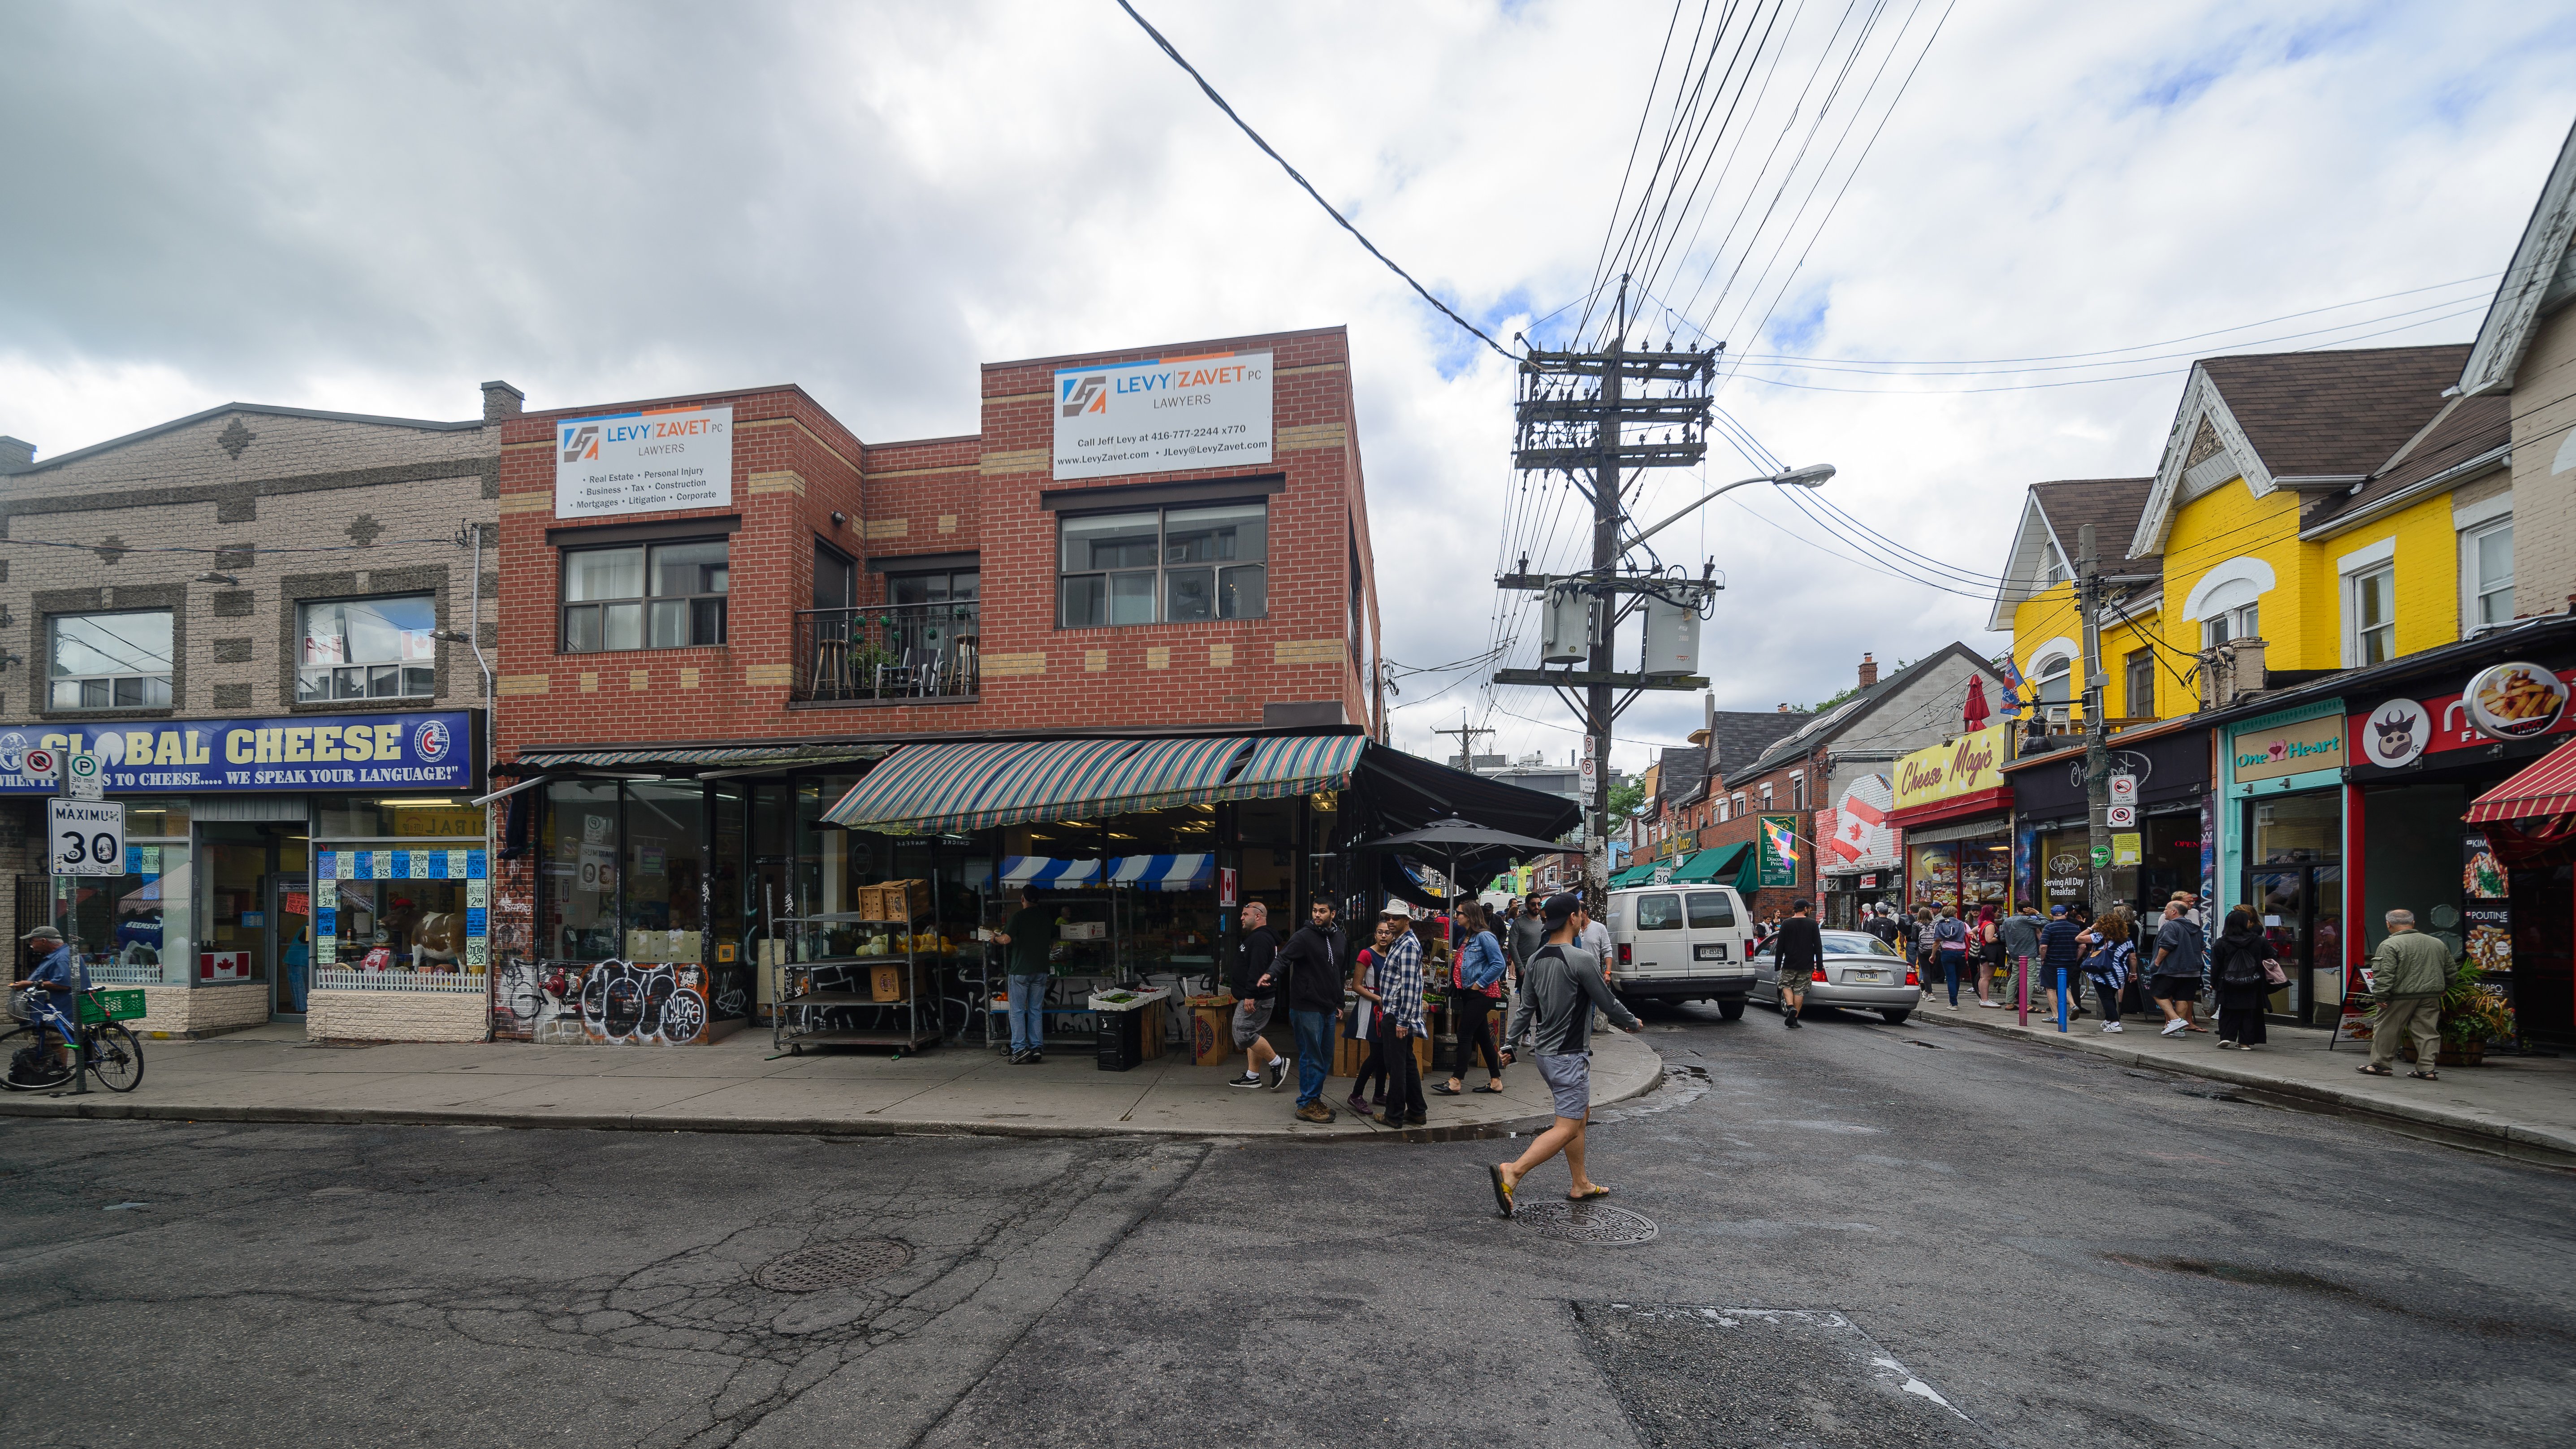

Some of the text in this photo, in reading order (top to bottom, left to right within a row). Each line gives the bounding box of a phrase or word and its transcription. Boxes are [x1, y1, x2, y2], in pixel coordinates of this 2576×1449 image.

[1117, 365, 1262, 394] LEVY ZAVET PC
[1154, 394, 1211, 409] LAWYERS
[607, 419, 723, 442] LEVY ZAVET PC
[1078, 424, 1246, 447] Call Jeff Levy at 416-777-2244 x770
[638, 443, 685, 456] LAWYERS
[1057, 440, 1268, 465] www.LevyZavet.com JLevy@LevyZavet.com
[589, 467, 704, 484] Real Estate Personal Injury
[587, 479, 706, 496] Business Tax Construction
[577, 490, 717, 510] Mortgages Litigation Corporate
[225, 724, 402, 765] CHEESE
[2236, 736, 2340, 768] One Heart
[1902, 740, 1993, 796] Cheese Magic
[116, 773, 135, 786] TO
[225, 770, 250, 785] WE
[255, 768, 310, 784] SPEAK
[311, 768, 355, 783] YOUR
[61, 830, 118, 865] 30
[2174, 840, 2200, 848] OPEN
[1656, 875, 1669, 883] 30
[2044, 878, 2064, 888] Serving
[2073, 878, 2084, 887] Day
[2051, 887, 2076, 895] Breakfast
[2472, 911, 2508, 920] POUTINE
[125, 921, 162, 930] BEEMSTE
[467, 944, 486, 955] STILTON
[1200, 1022, 1212, 1051] BONIPAK
